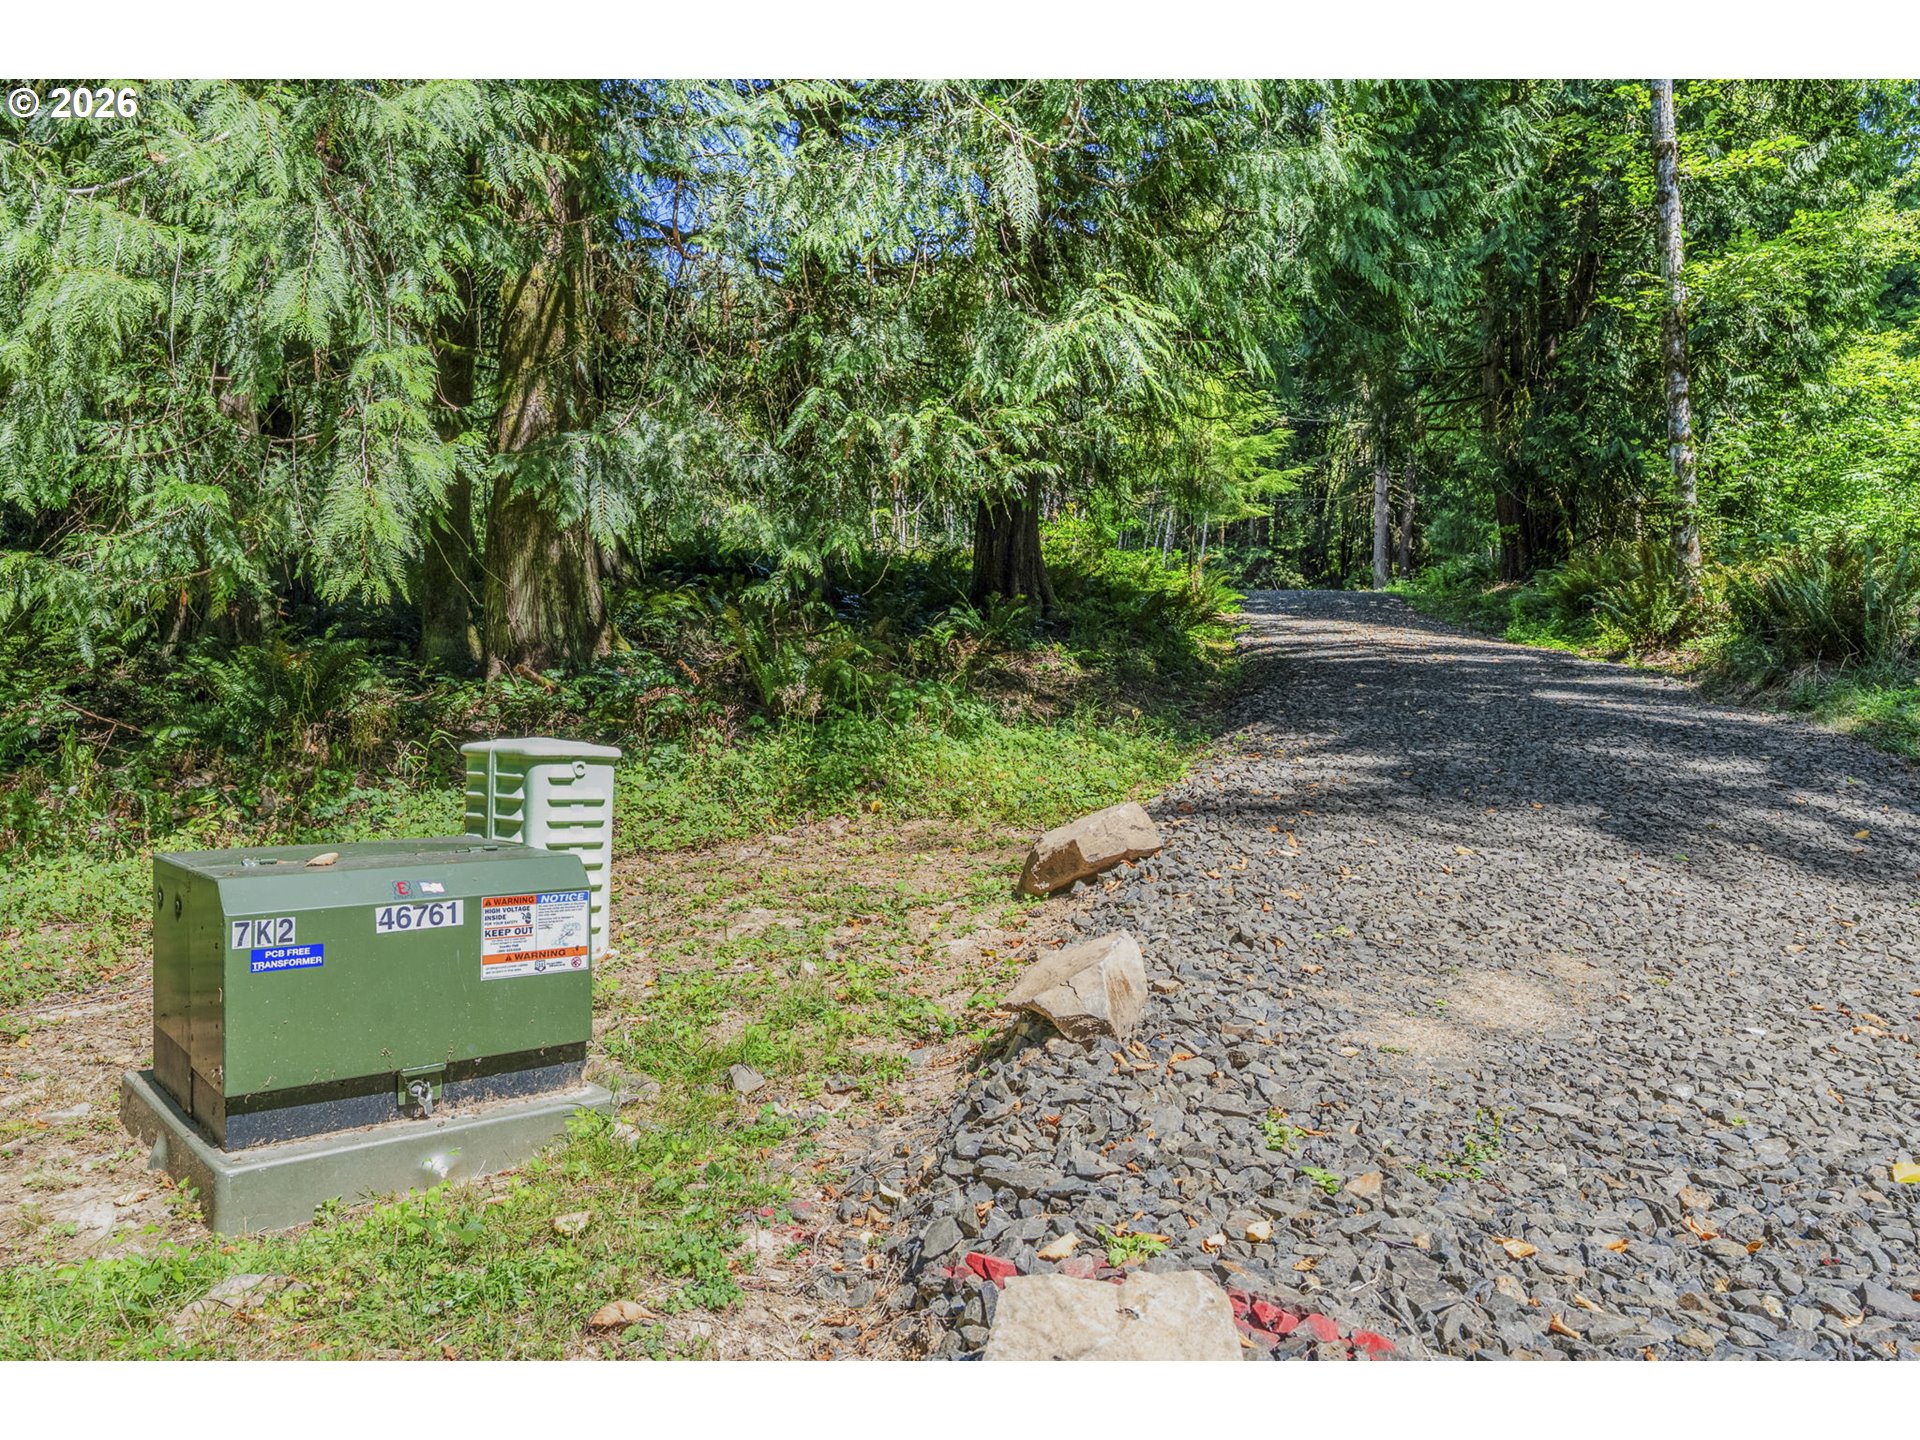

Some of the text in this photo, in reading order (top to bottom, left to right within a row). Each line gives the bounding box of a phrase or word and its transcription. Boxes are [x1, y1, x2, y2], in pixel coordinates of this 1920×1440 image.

[493, 896, 535, 905] WARNING
[540, 893, 585, 903] NOTICE
[378, 902, 457, 930] 46761
[234, 918, 294, 947] 7K2
[485, 927, 534, 938] KEEP OUT
[265, 947, 311, 959] PCB FREE
[514, 949, 566, 960] WARNING
[252, 956, 322, 971] TRANSFORMER
